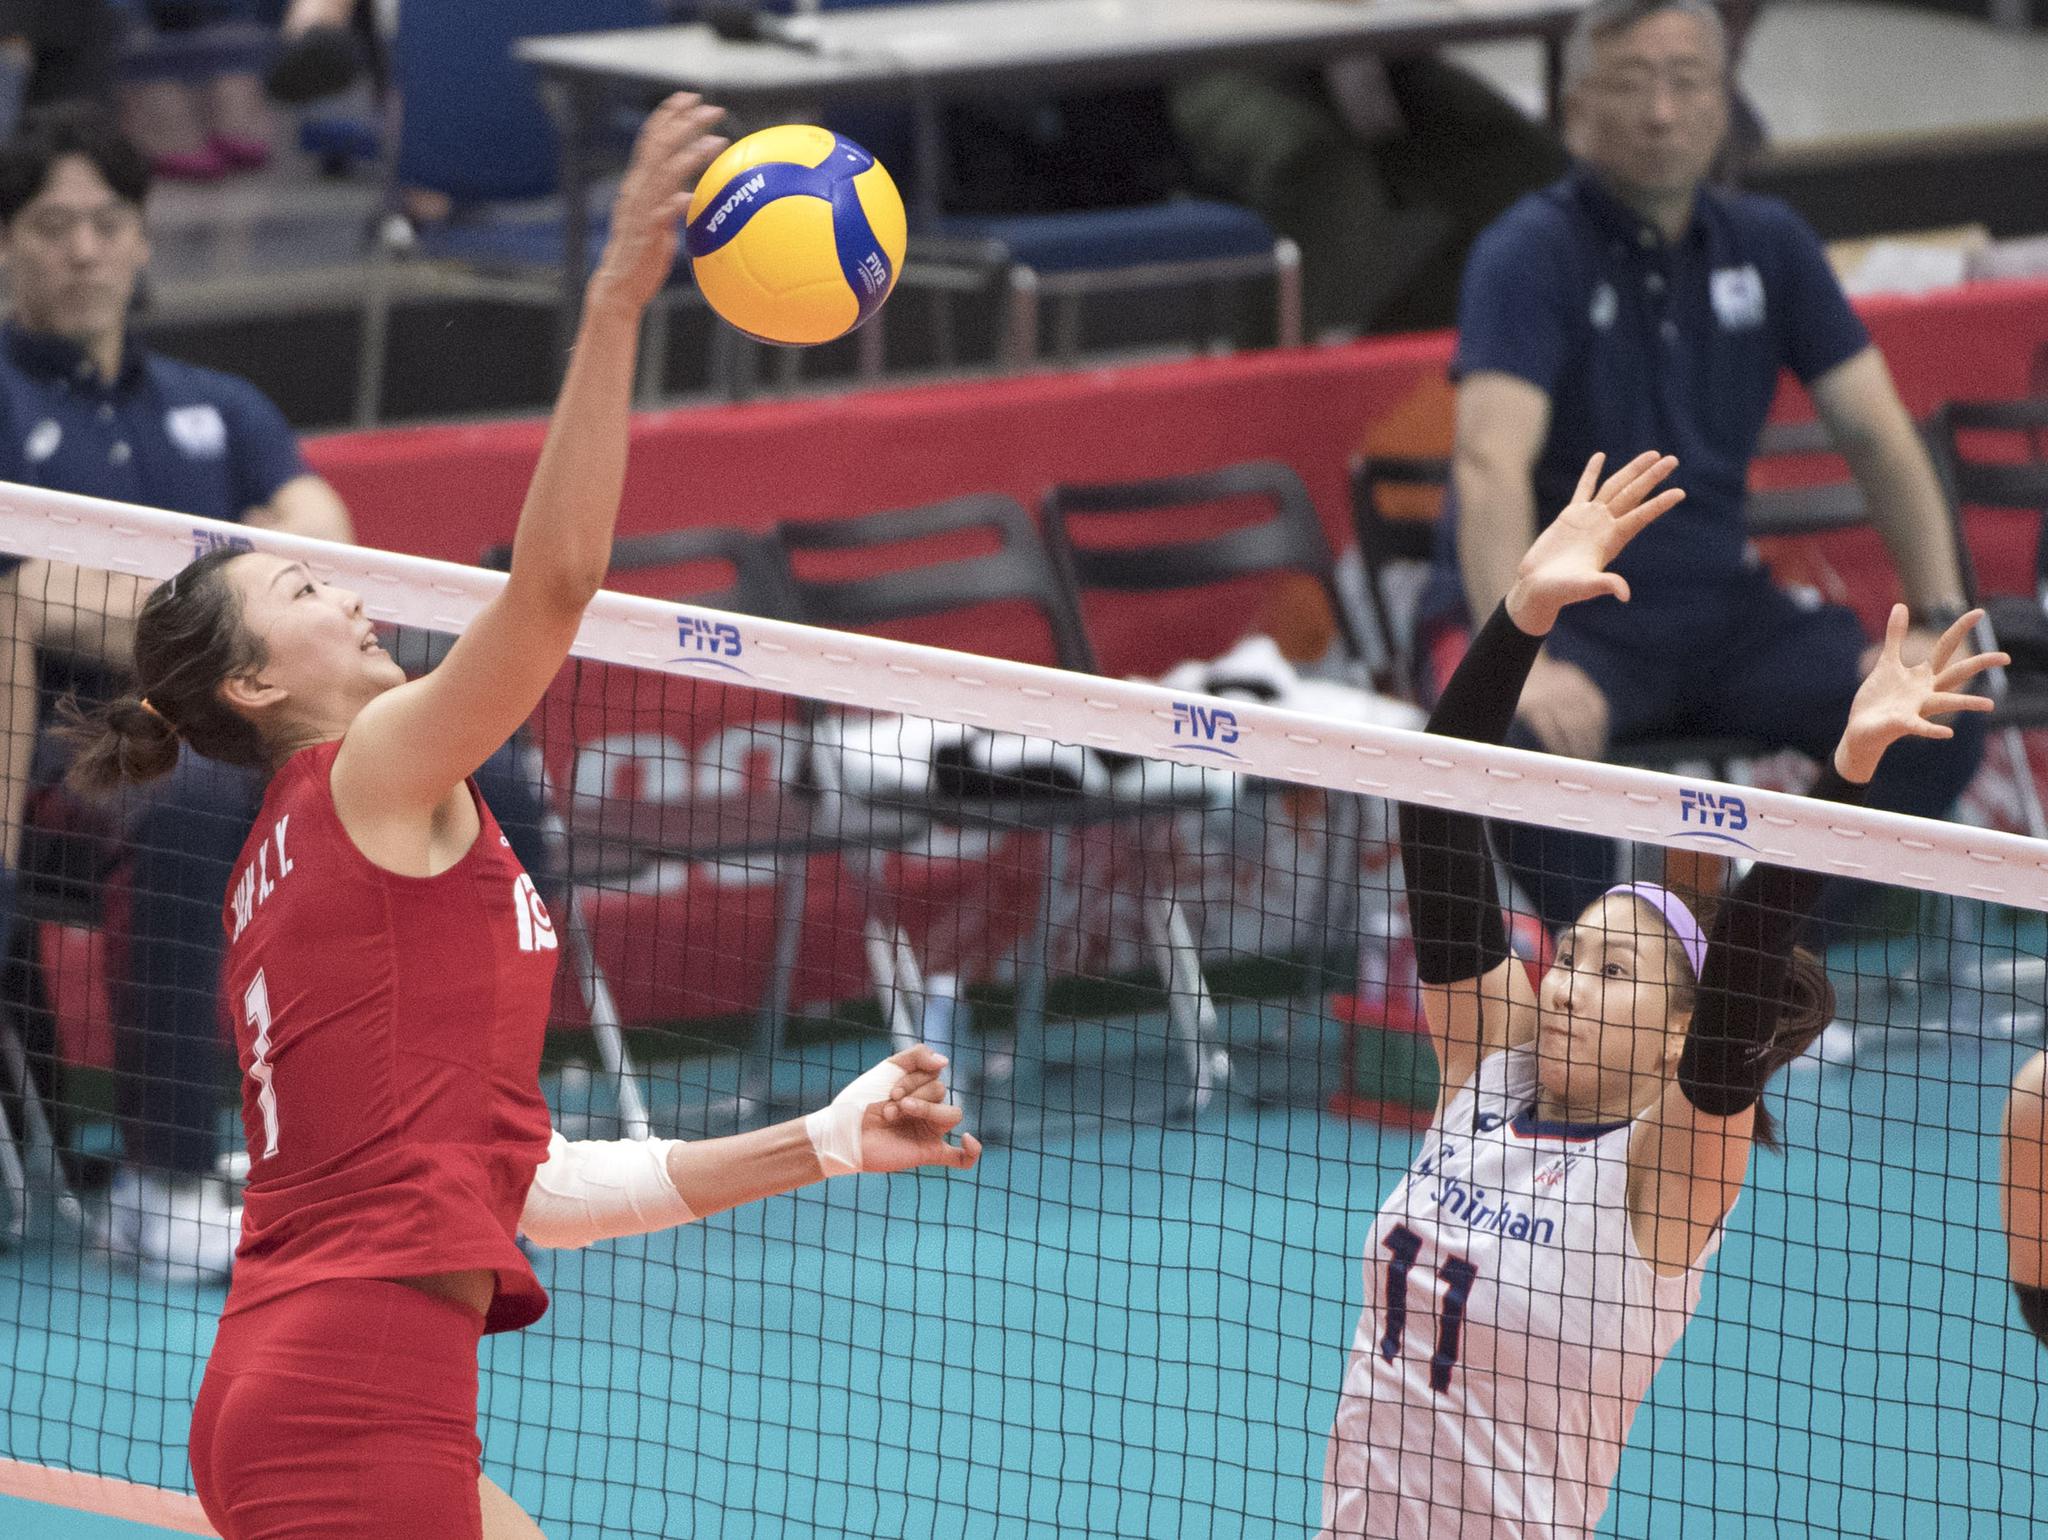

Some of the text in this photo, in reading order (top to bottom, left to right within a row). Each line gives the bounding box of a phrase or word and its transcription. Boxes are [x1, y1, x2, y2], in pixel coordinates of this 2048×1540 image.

[865, 251, 886, 286] FIVB
[677, 616, 742, 656] FIVB
[1172, 702, 1239, 744] FIVB
[1679, 788, 1747, 830] FIVB
[245, 966, 280, 1159] 1
[1382, 1222, 1479, 1394] 11
